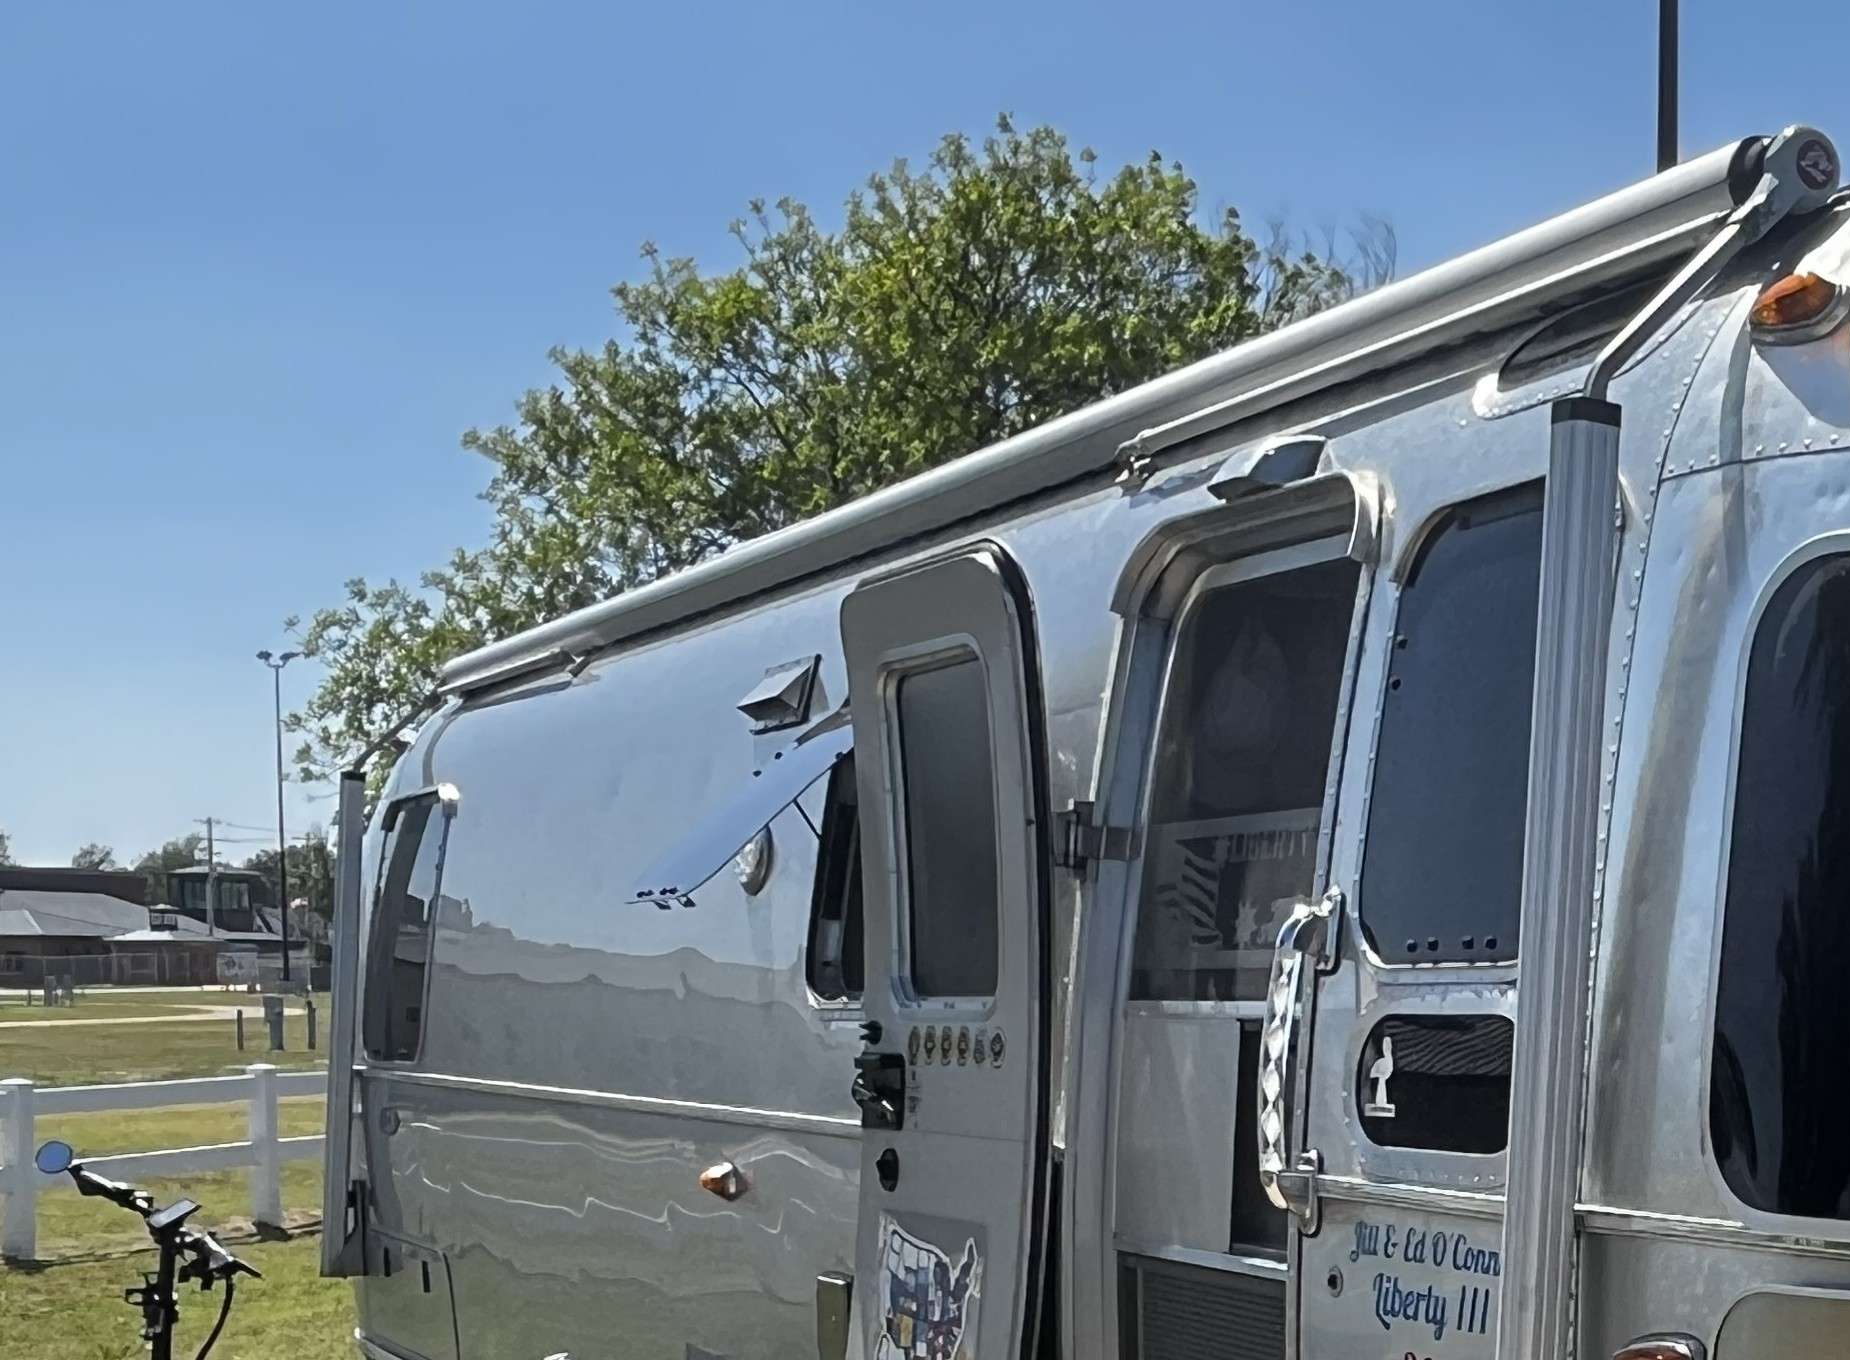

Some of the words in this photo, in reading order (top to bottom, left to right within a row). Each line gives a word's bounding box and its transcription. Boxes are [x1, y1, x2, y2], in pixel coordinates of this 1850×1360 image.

[1403, 1227, 1427, 1264] Ed
[1373, 1272, 1447, 1341] Liberty
[1457, 1285, 1490, 1334] III
